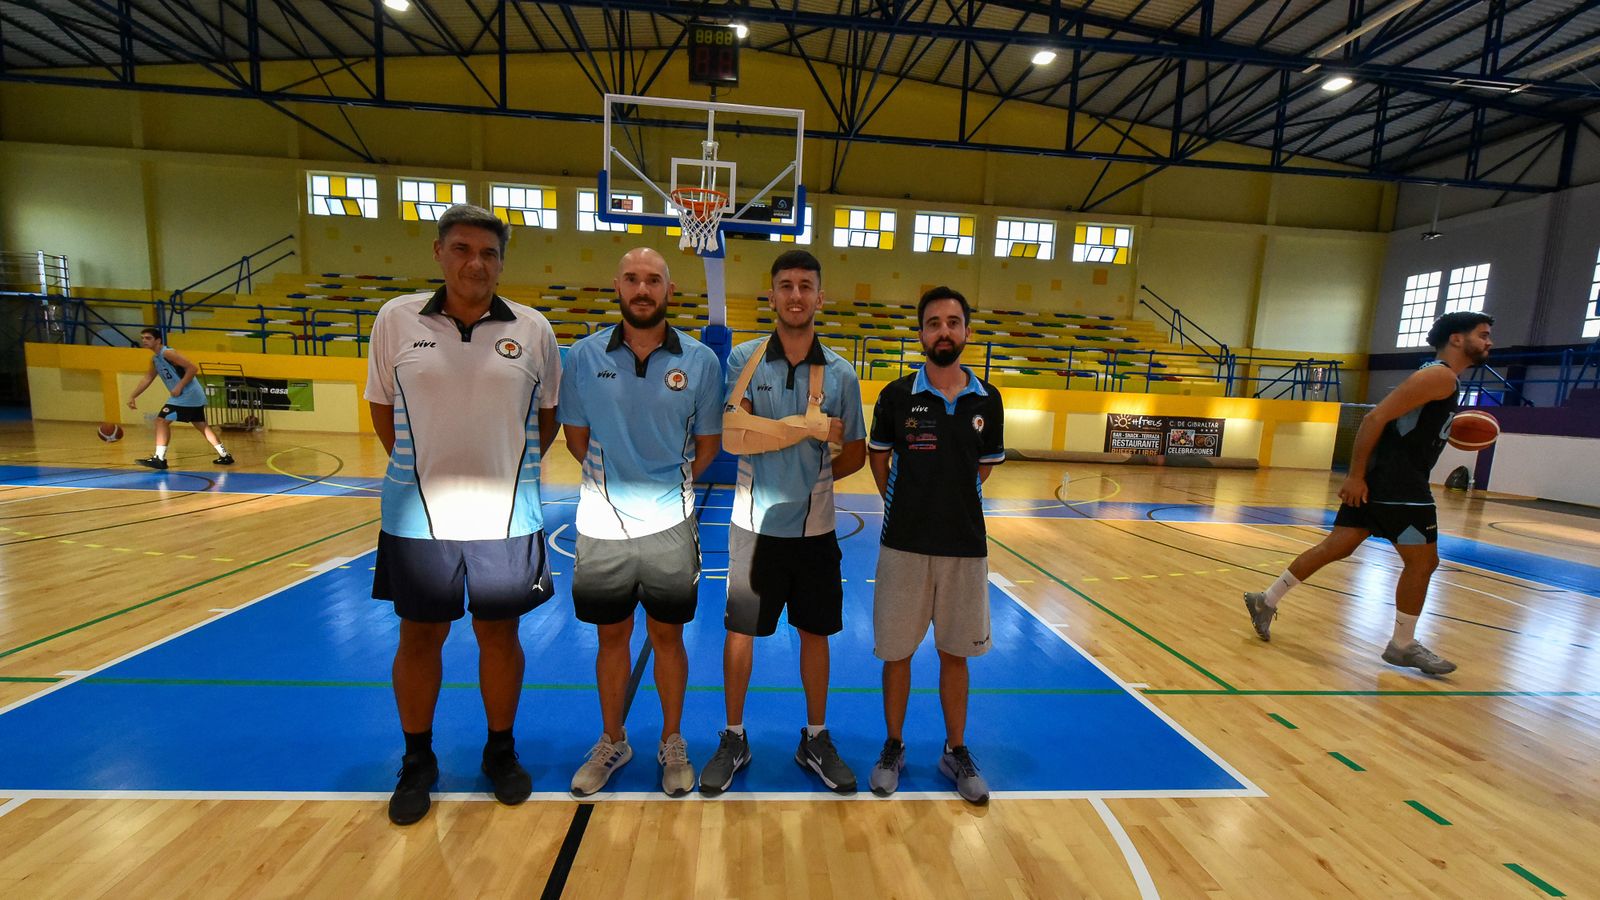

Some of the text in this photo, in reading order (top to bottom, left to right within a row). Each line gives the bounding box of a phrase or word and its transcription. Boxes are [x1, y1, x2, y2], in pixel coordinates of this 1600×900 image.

[269, 387, 289, 395] casa
[1187, 421, 1219, 429] GIBRALTAR
[1112, 438, 1160, 449] RESTAURANTE
[1167, 446, 1214, 455] CELEBRACIONES
